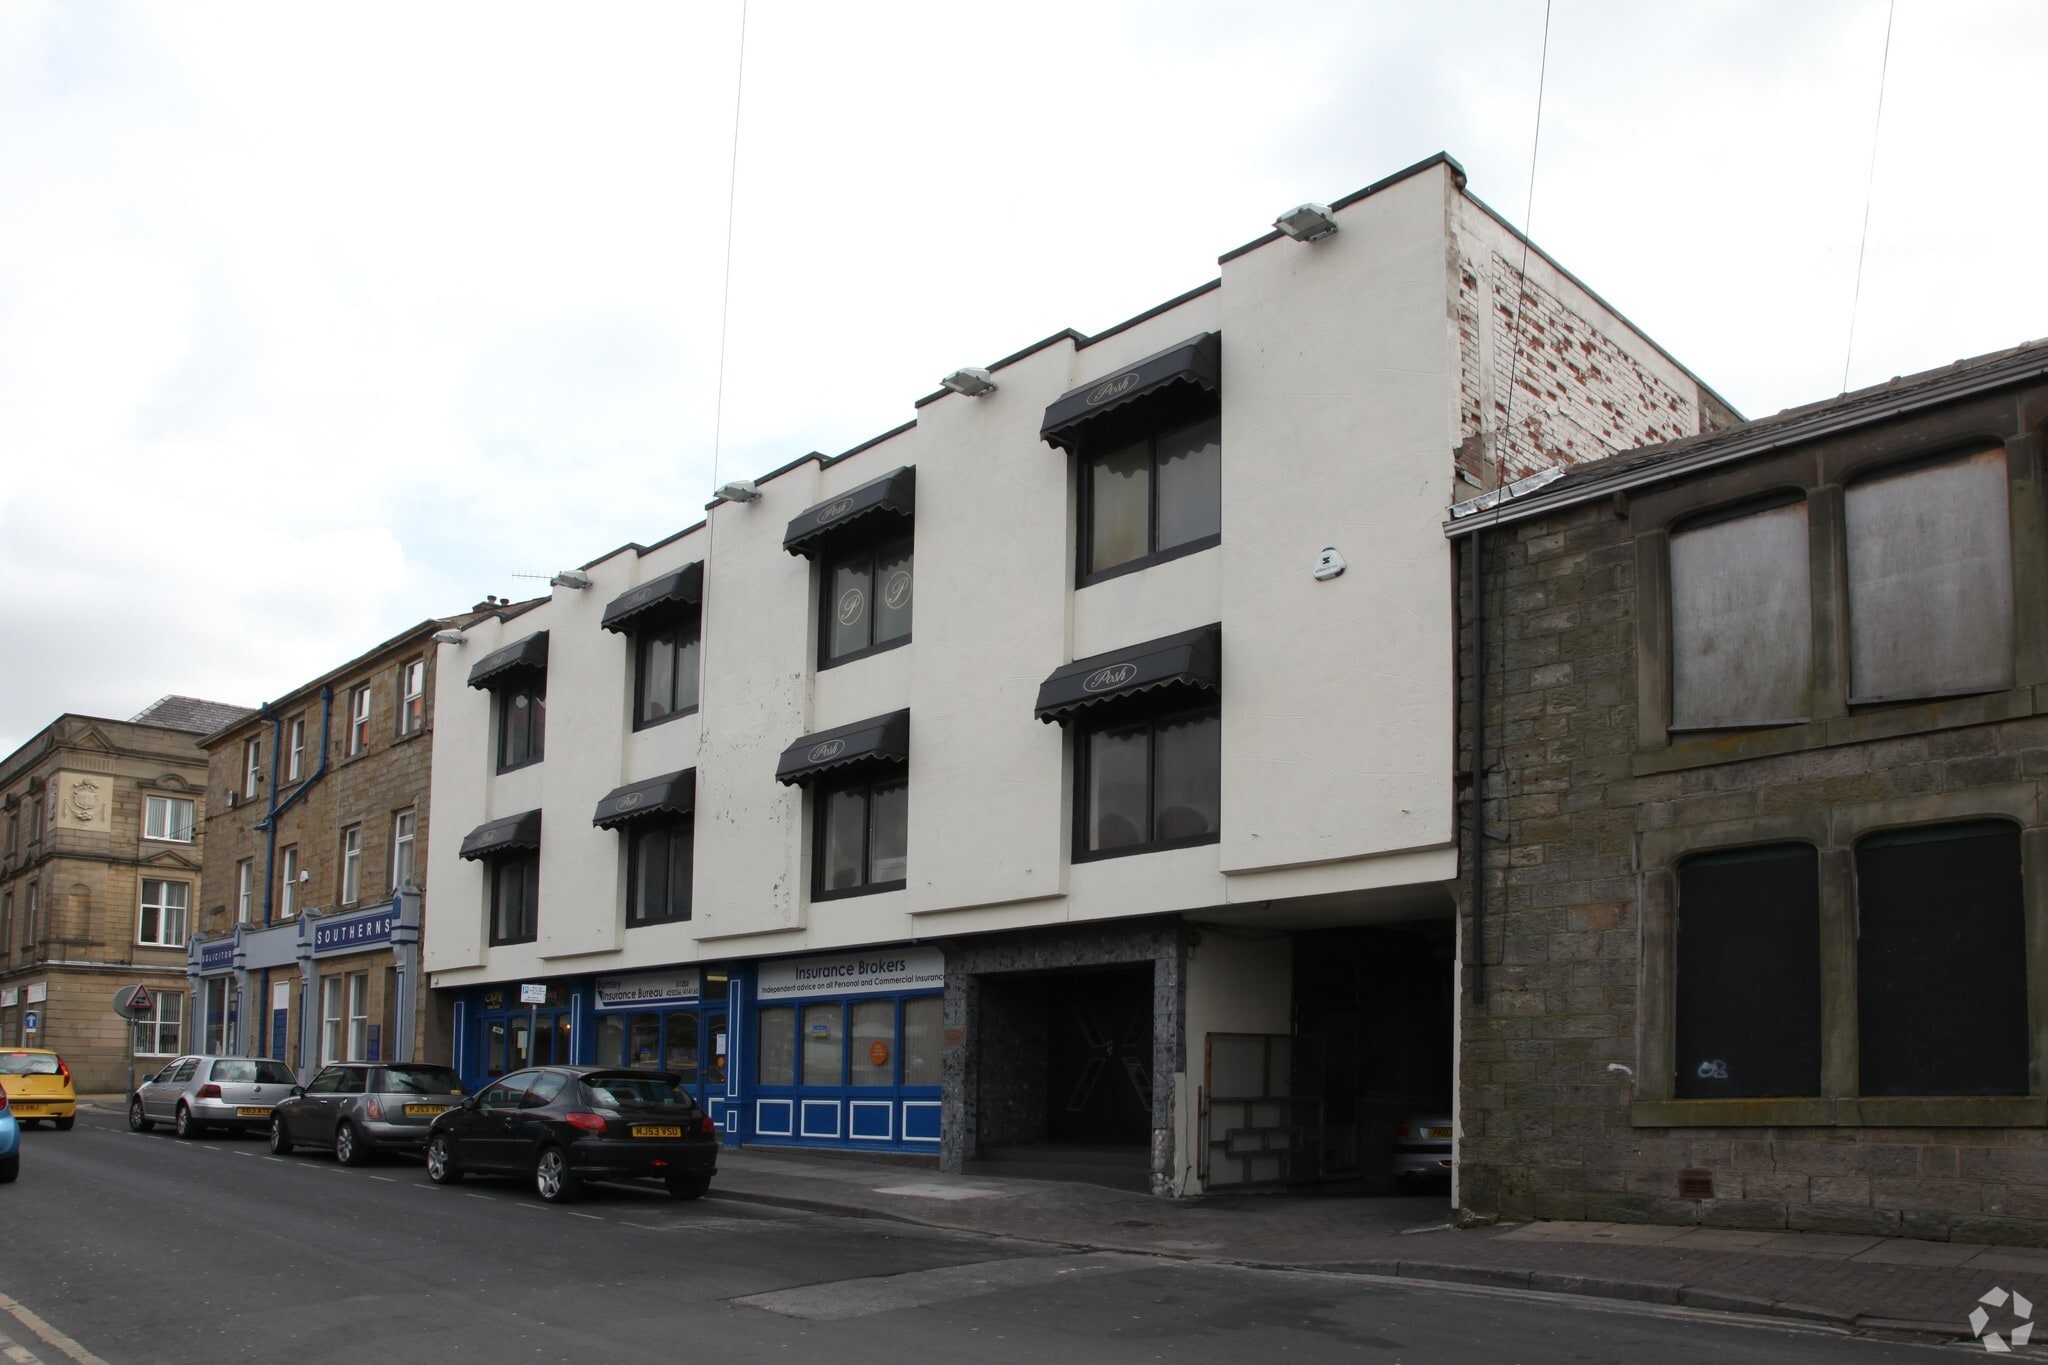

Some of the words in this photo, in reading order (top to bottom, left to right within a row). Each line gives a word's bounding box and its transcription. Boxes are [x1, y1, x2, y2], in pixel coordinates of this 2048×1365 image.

[1094, 376, 1130, 402] Posh
[821, 502, 848, 521] Posh
[889, 577, 909, 603] P
[841, 594, 861, 619] P
[1091, 667, 1127, 689] Posh
[813, 742, 839, 760] Posh
[317, 918, 390, 945] SOUTHERNS
[795, 963, 855, 981] Insurance
[858, 957, 906, 976] Brokers
[602, 988, 636, 1001] Insurance
[637, 986, 663, 999] Bureau
[761, 984, 796, 994] Independent
[797, 982, 816, 991] advice
[826, 980, 834, 989] all
[834, 978, 860, 988] Personal
[860, 977, 873, 987] and
[874, 974, 914, 986] Commercial
[914, 974, 945, 983] Insuranc
